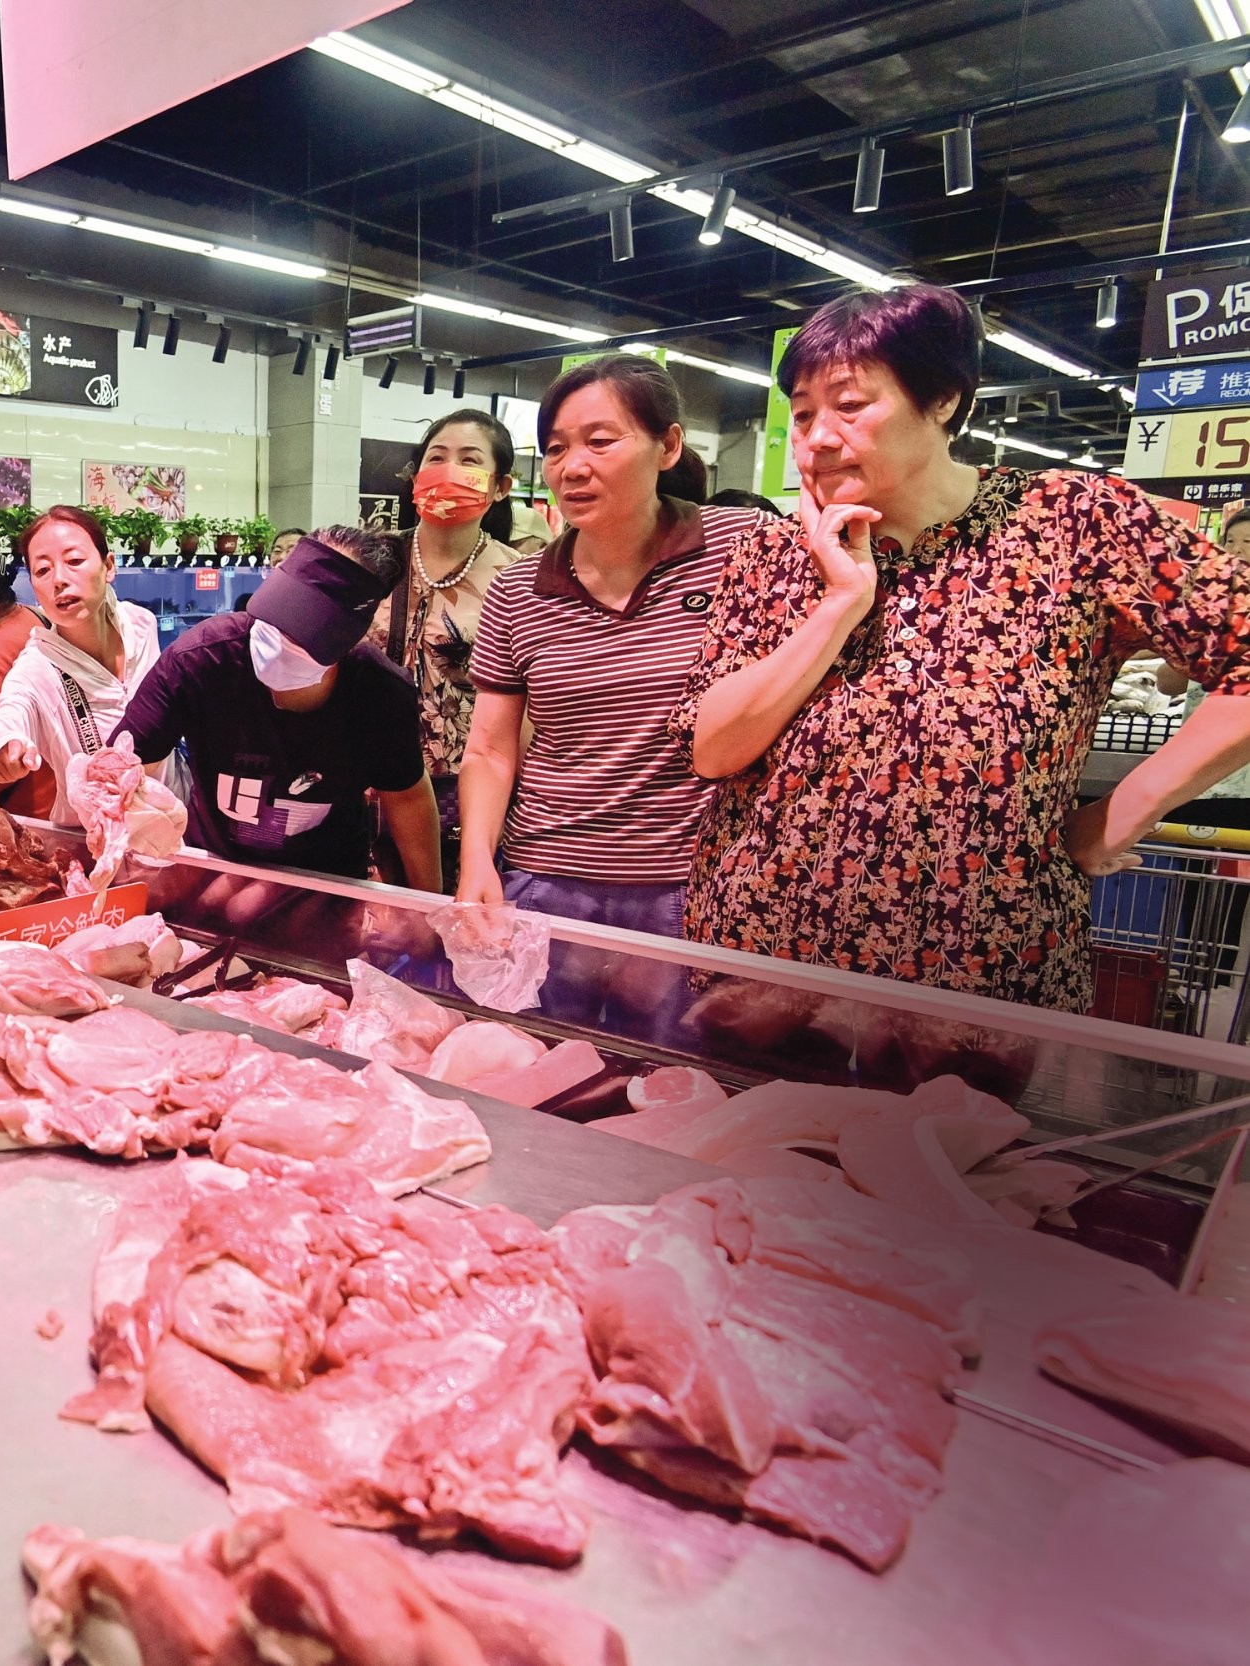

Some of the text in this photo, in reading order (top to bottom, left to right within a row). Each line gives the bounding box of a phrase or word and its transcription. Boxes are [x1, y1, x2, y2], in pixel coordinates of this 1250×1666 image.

[42, 333, 72, 353] 水产
[42, 353, 97, 369] Aquatic product
[1168, 368, 1207, 397] 荐
[1195, 416, 1250, 469] 15
